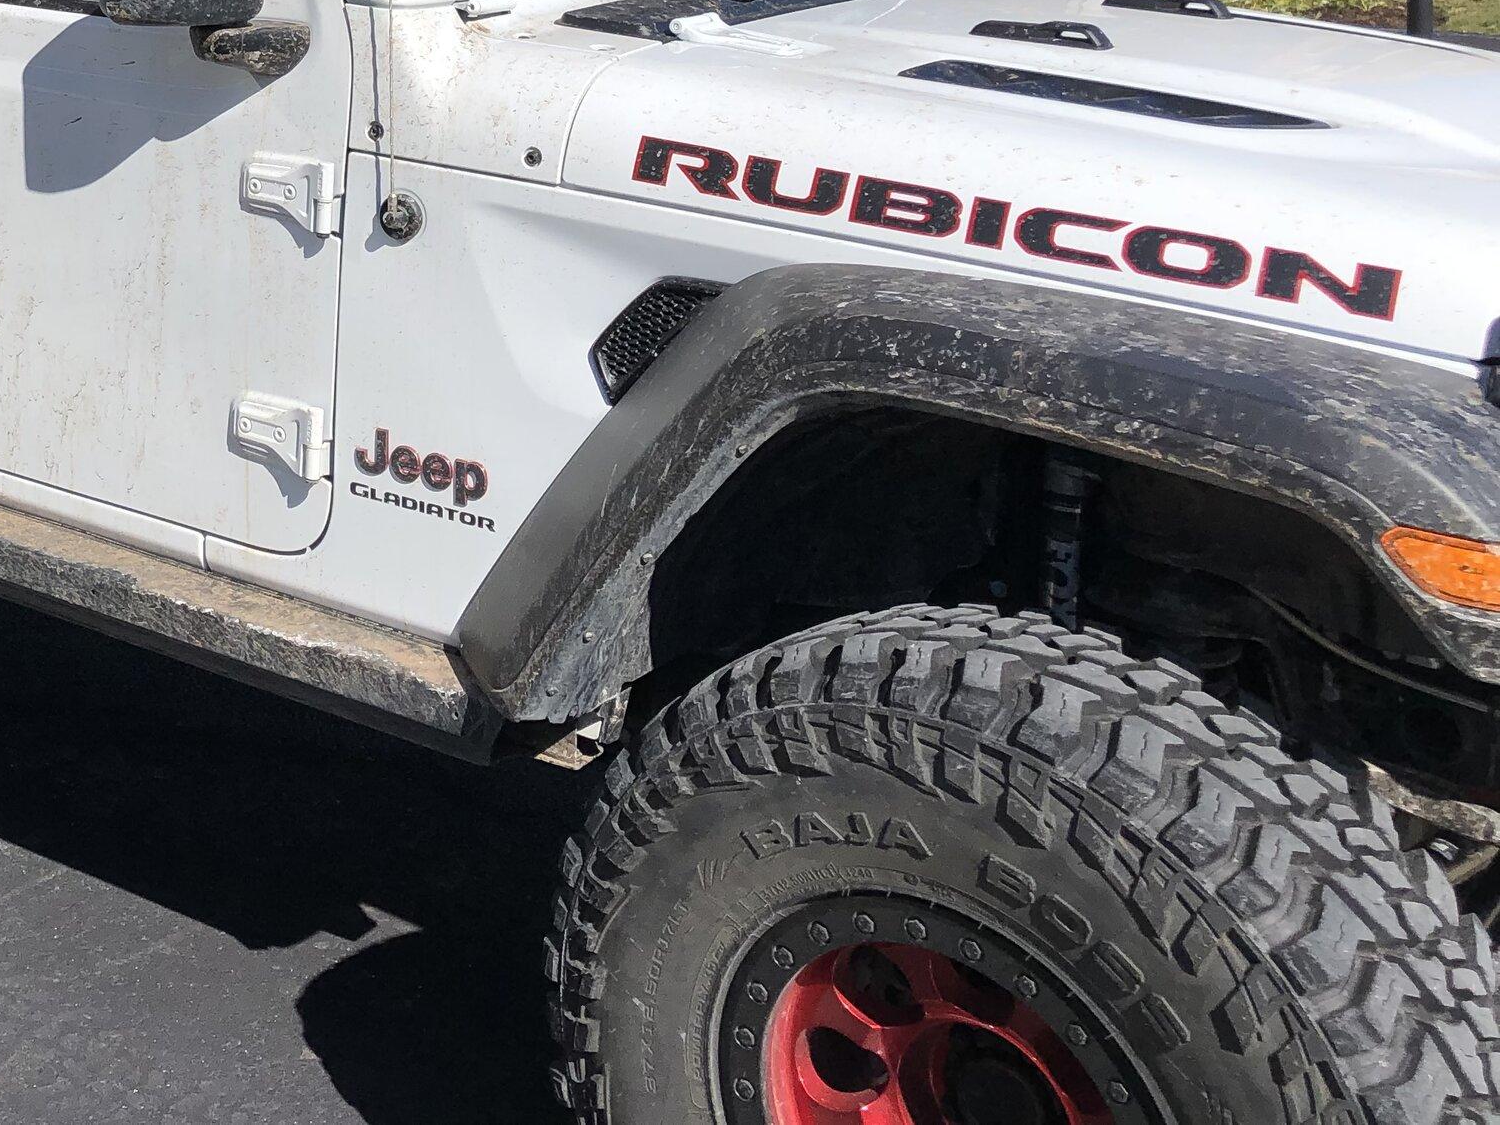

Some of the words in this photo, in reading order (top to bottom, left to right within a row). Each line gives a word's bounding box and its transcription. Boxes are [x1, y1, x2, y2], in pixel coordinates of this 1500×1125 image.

[632, 135, 1403, 322] RUBICON
[350, 481, 496, 533] GLADIATOR
[354, 427, 488, 507] Jeep
[739, 811, 934, 861] BAJA
[978, 853, 1191, 1051] BOSS
